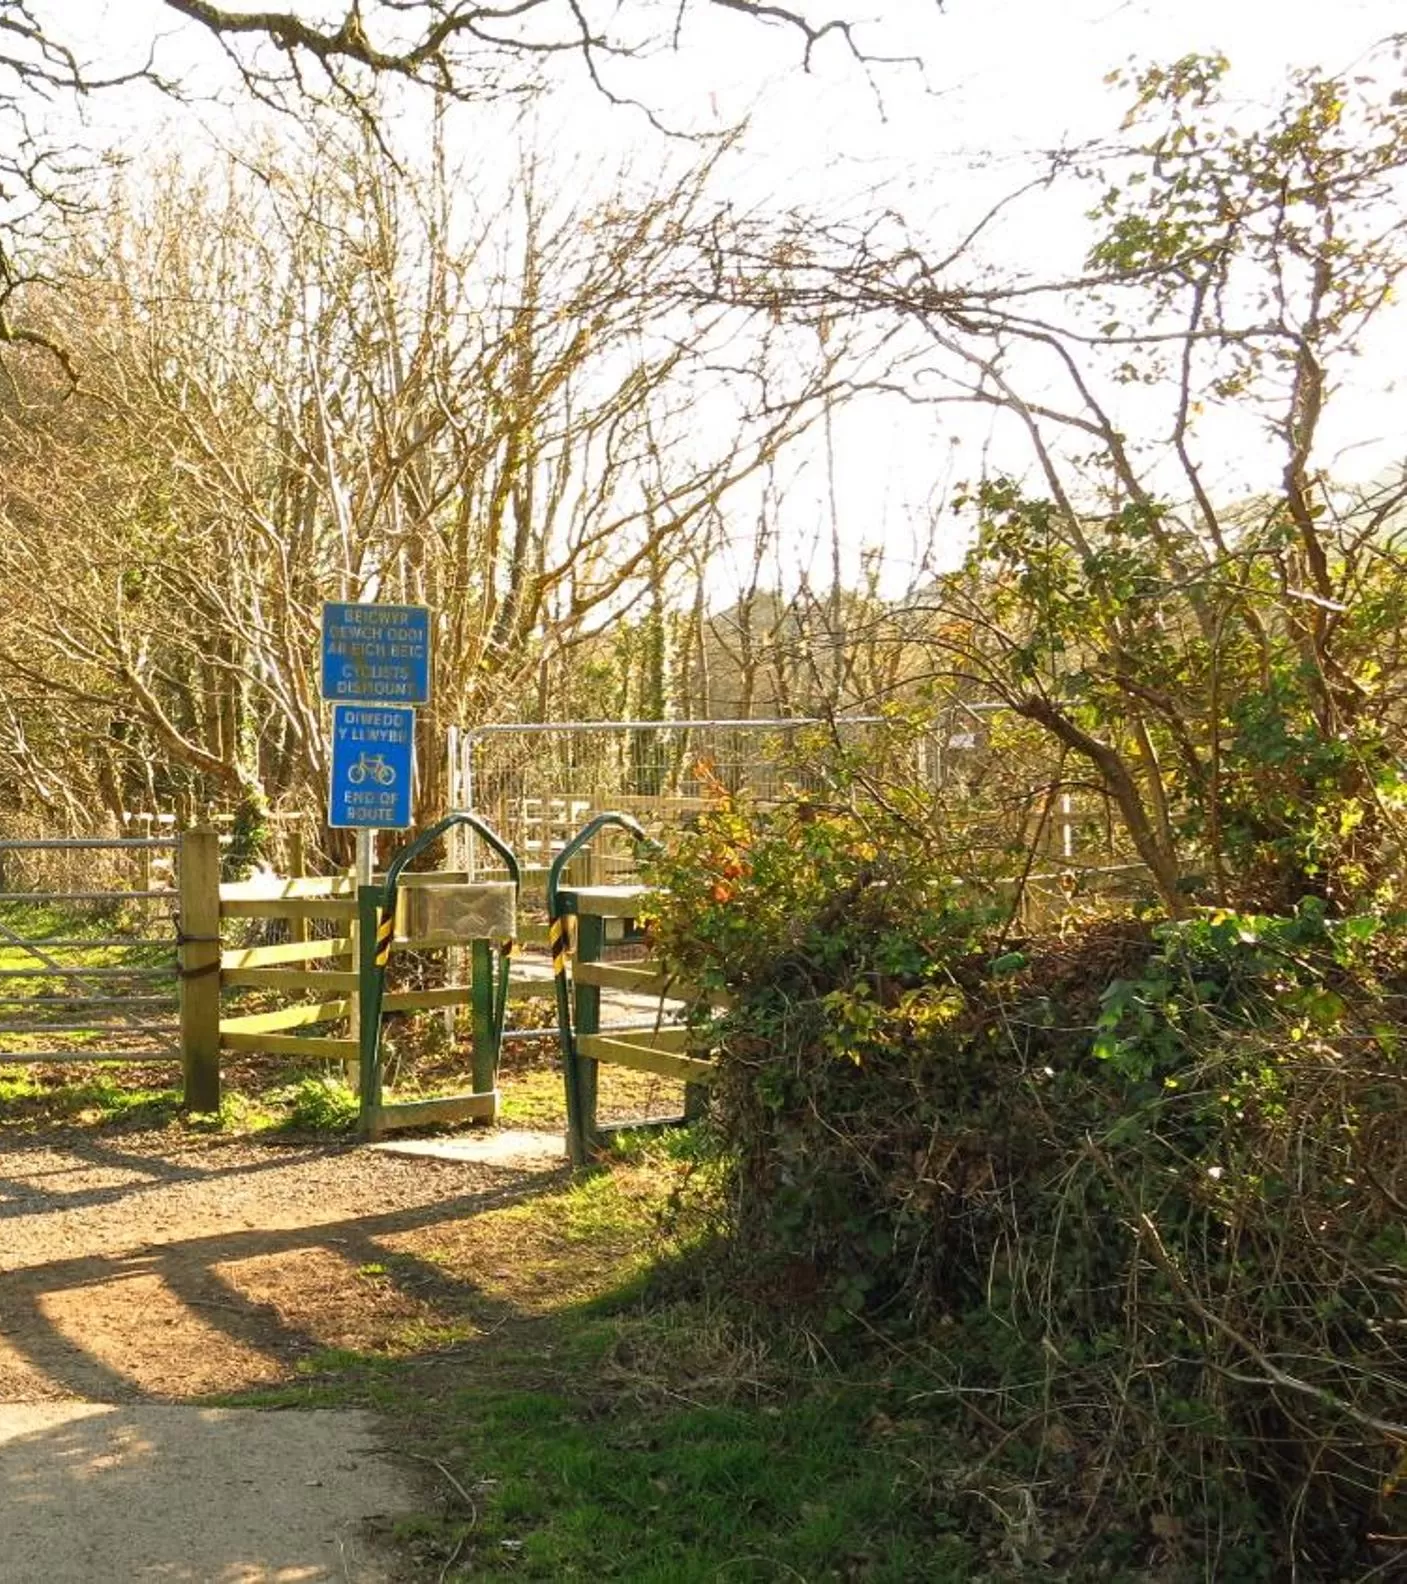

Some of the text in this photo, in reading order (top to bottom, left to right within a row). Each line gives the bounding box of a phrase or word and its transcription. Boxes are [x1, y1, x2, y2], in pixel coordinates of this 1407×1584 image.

[391, 644, 424, 659] BEIC
[344, 712, 403, 727] DIWEDD
[339, 728, 348, 741] Y
[344, 791, 399, 805] END OF
[347, 807, 394, 820] ROUTE
